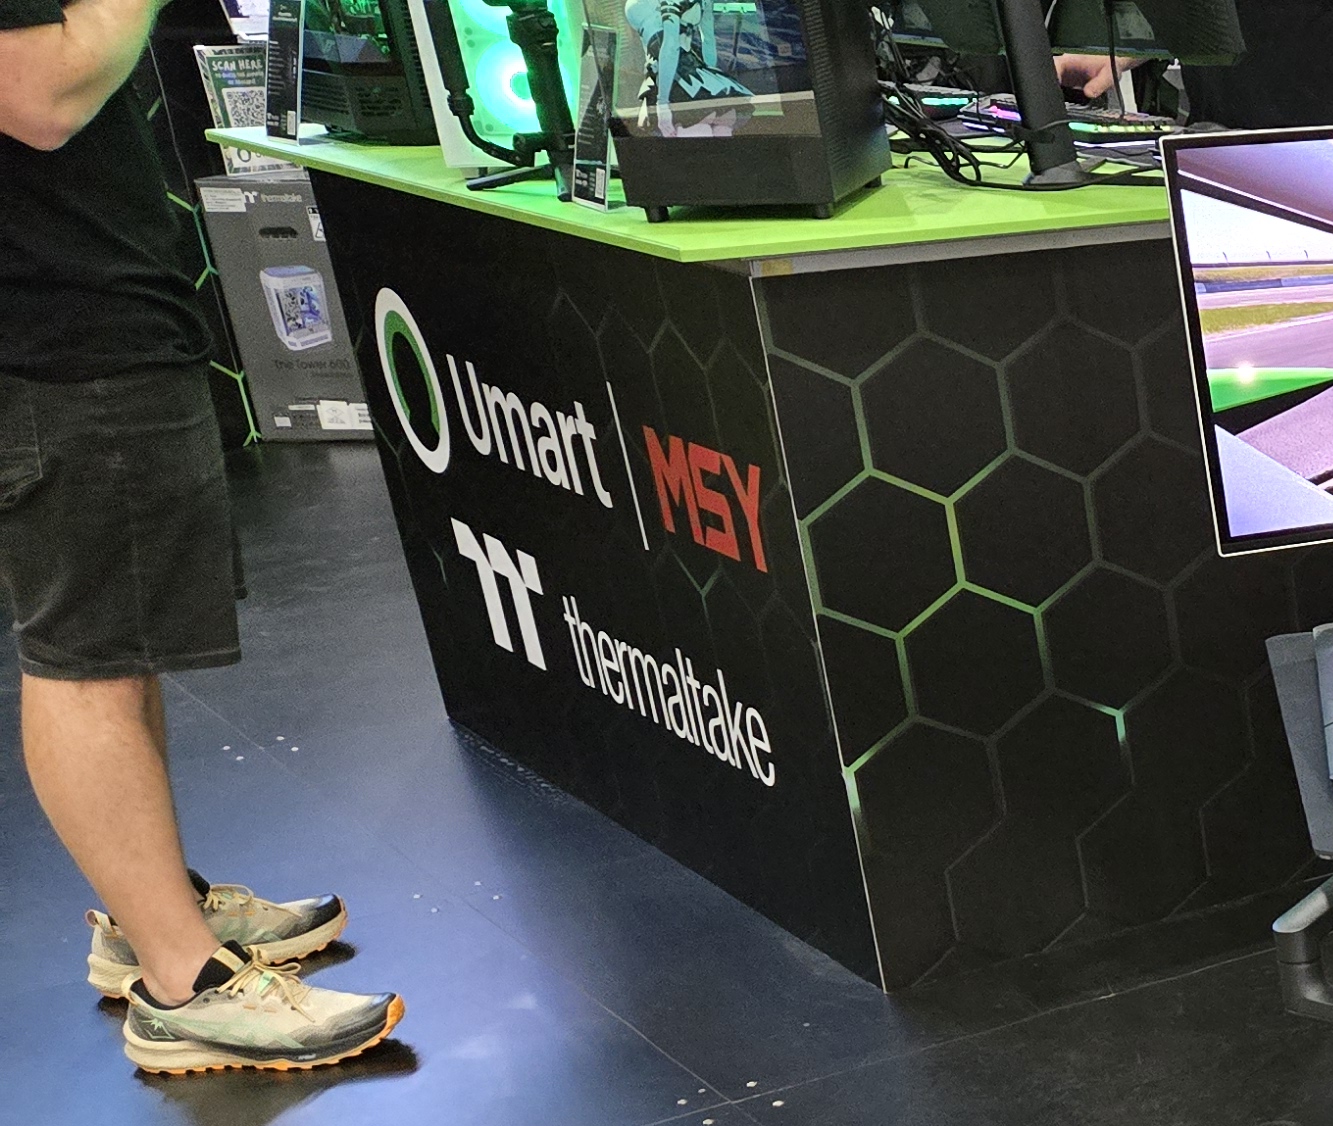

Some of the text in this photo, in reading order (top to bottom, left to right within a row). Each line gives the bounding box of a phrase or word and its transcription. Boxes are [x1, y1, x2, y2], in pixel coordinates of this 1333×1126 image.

[212, 59, 263, 71] SCAN HERE
[447, 354, 613, 508] Umart
[643, 425, 767, 573] MSY
[562, 596, 775, 787] thermaltake
